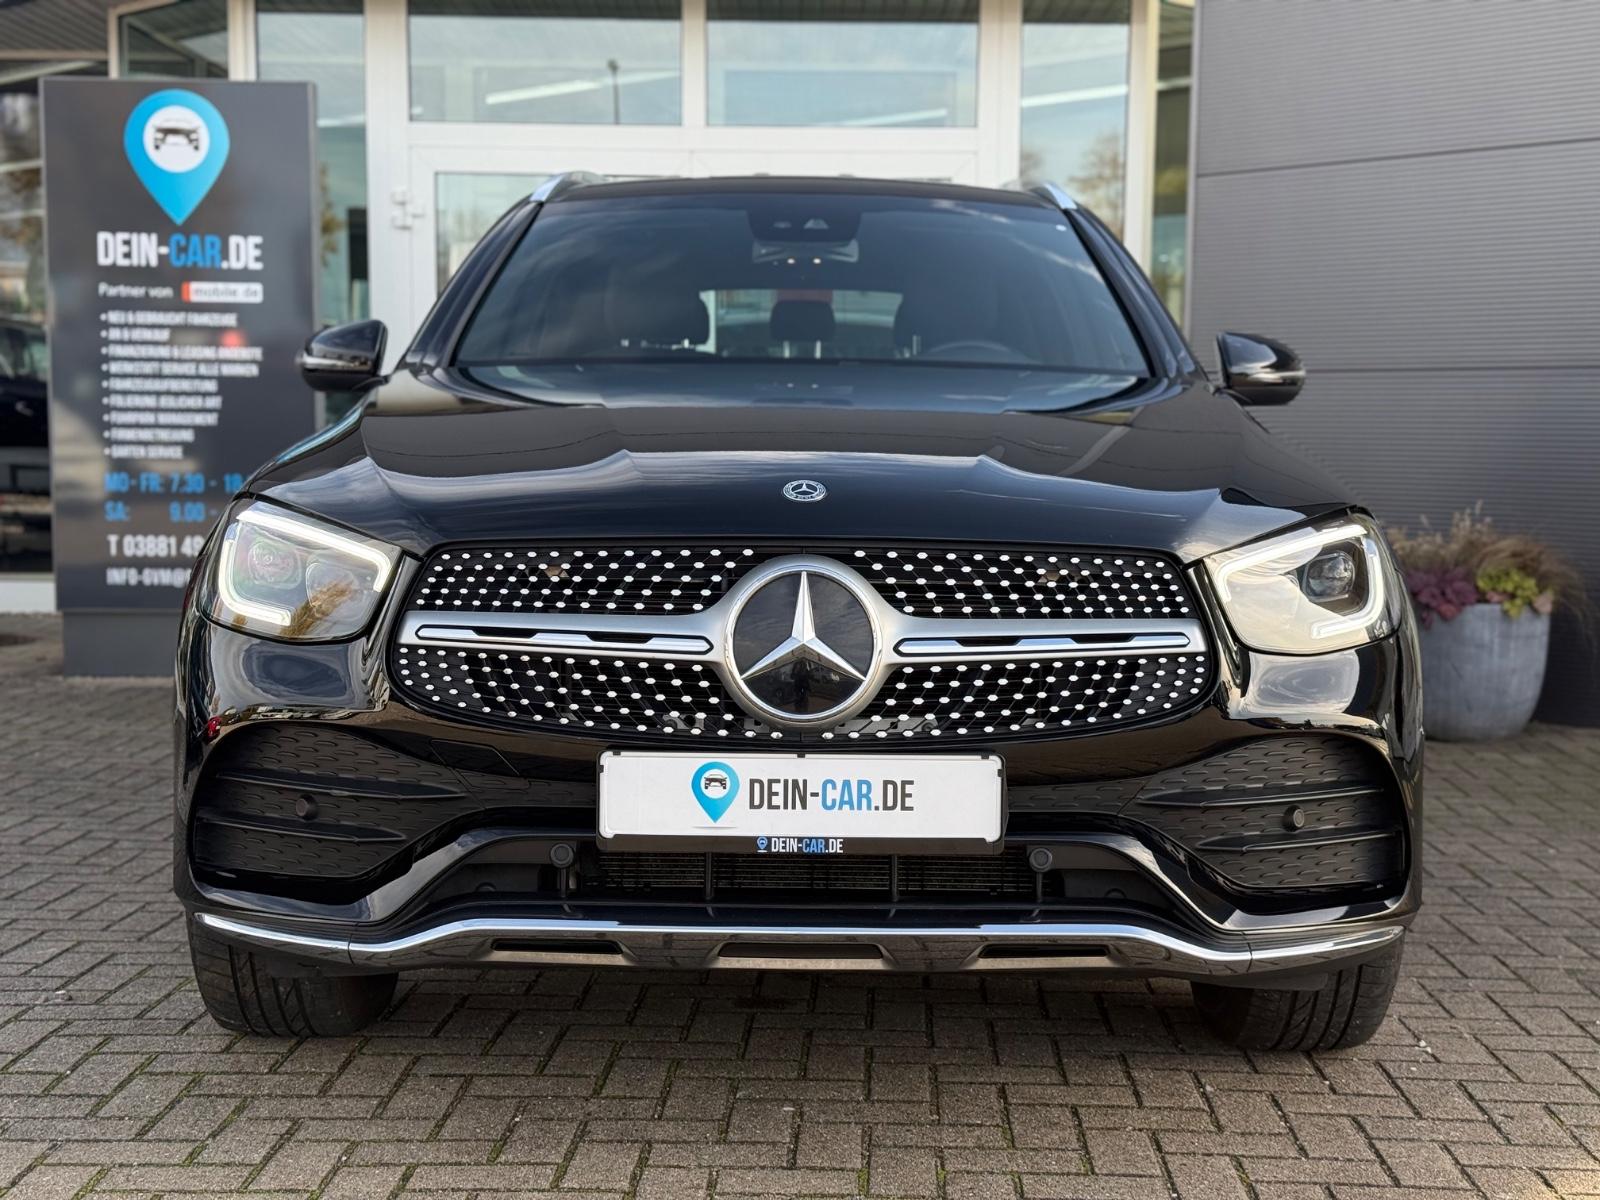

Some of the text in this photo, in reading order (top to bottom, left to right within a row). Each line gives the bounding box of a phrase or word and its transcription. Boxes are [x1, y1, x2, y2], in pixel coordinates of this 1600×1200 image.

[97, 231, 264, 270] DEIN-CAR.DE
[98, 282, 146, 297] Partner
[149, 286, 174, 298] von
[107, 534, 205, 557] T 03881 49
[749, 778, 914, 811] DEIN-CAR.DE
[771, 838, 843, 853] DEIN-CAR.DE
